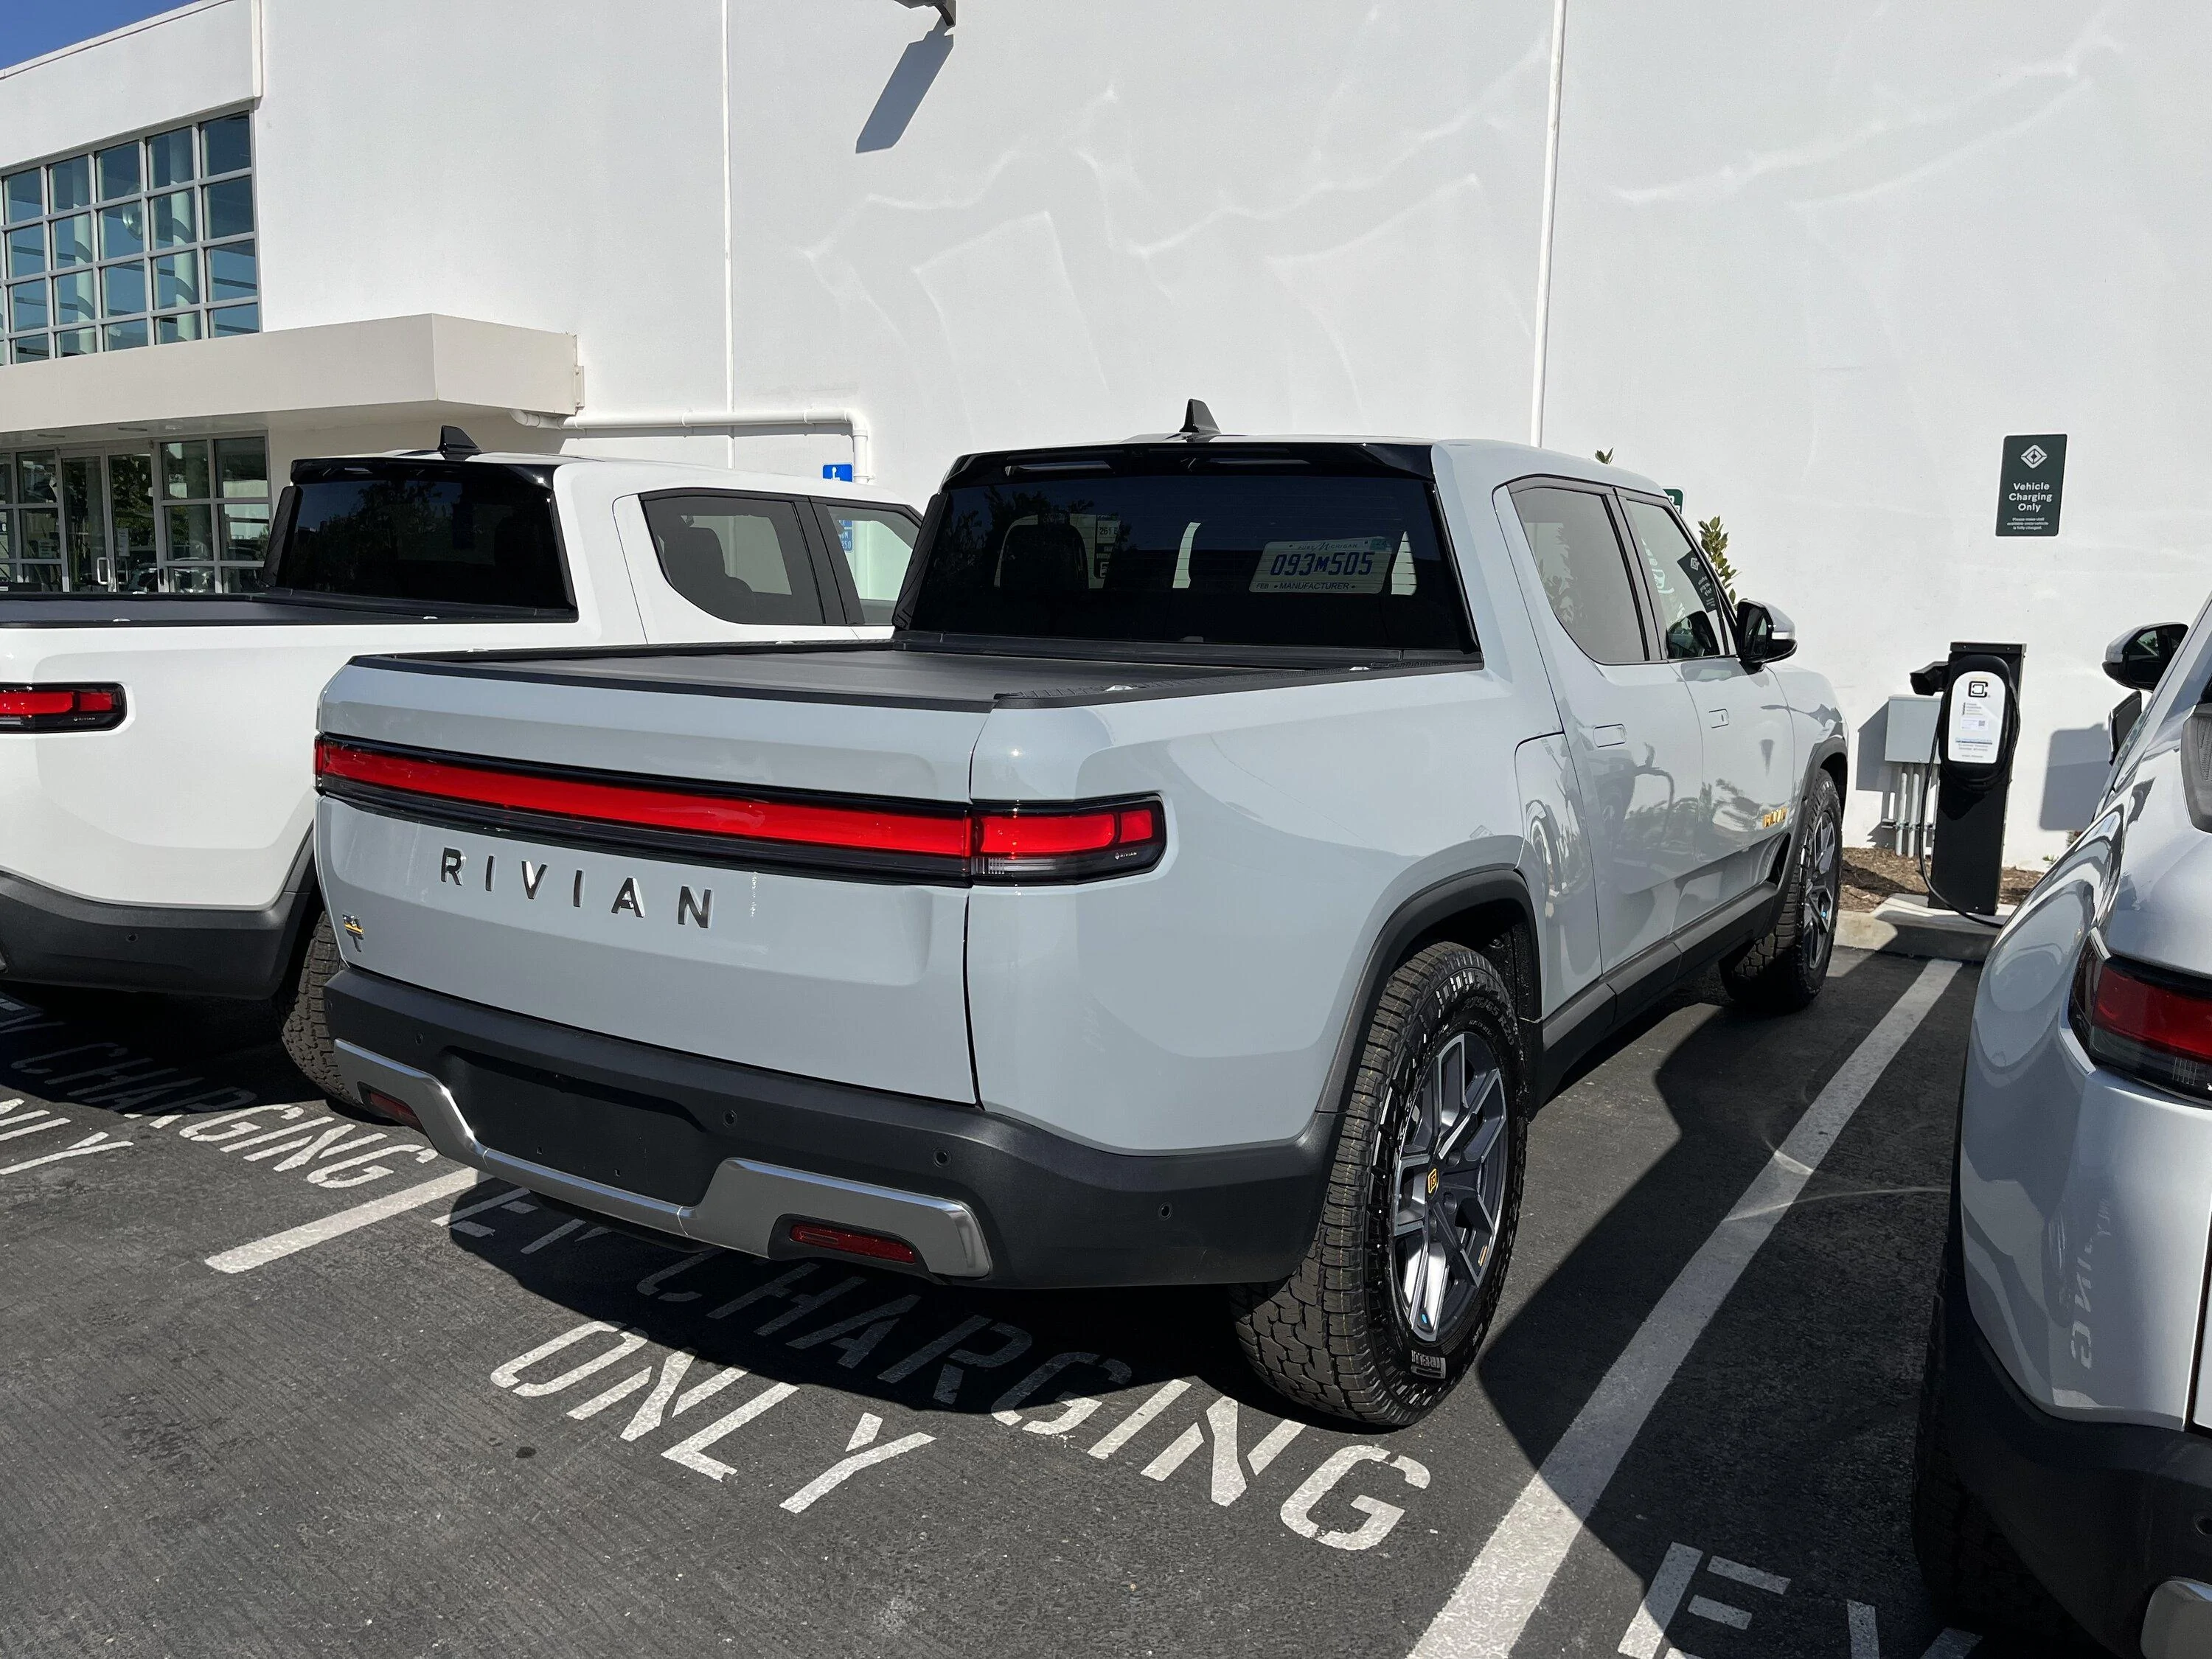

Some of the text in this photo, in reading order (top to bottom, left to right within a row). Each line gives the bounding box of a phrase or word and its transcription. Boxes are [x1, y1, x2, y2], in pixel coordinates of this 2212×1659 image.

[2008, 493, 2053, 502] Charging
[2013, 482, 2050, 490] Vehicle
[2018, 503, 2041, 512] Only
[1270, 552, 1376, 576] 093M505
[440, 846, 714, 929] RIVIAN
[10, 1041, 439, 1189] CHARGING
[490, 1321, 937, 1514] ONLY
[636, 1248, 1431, 1551] CHARGING
